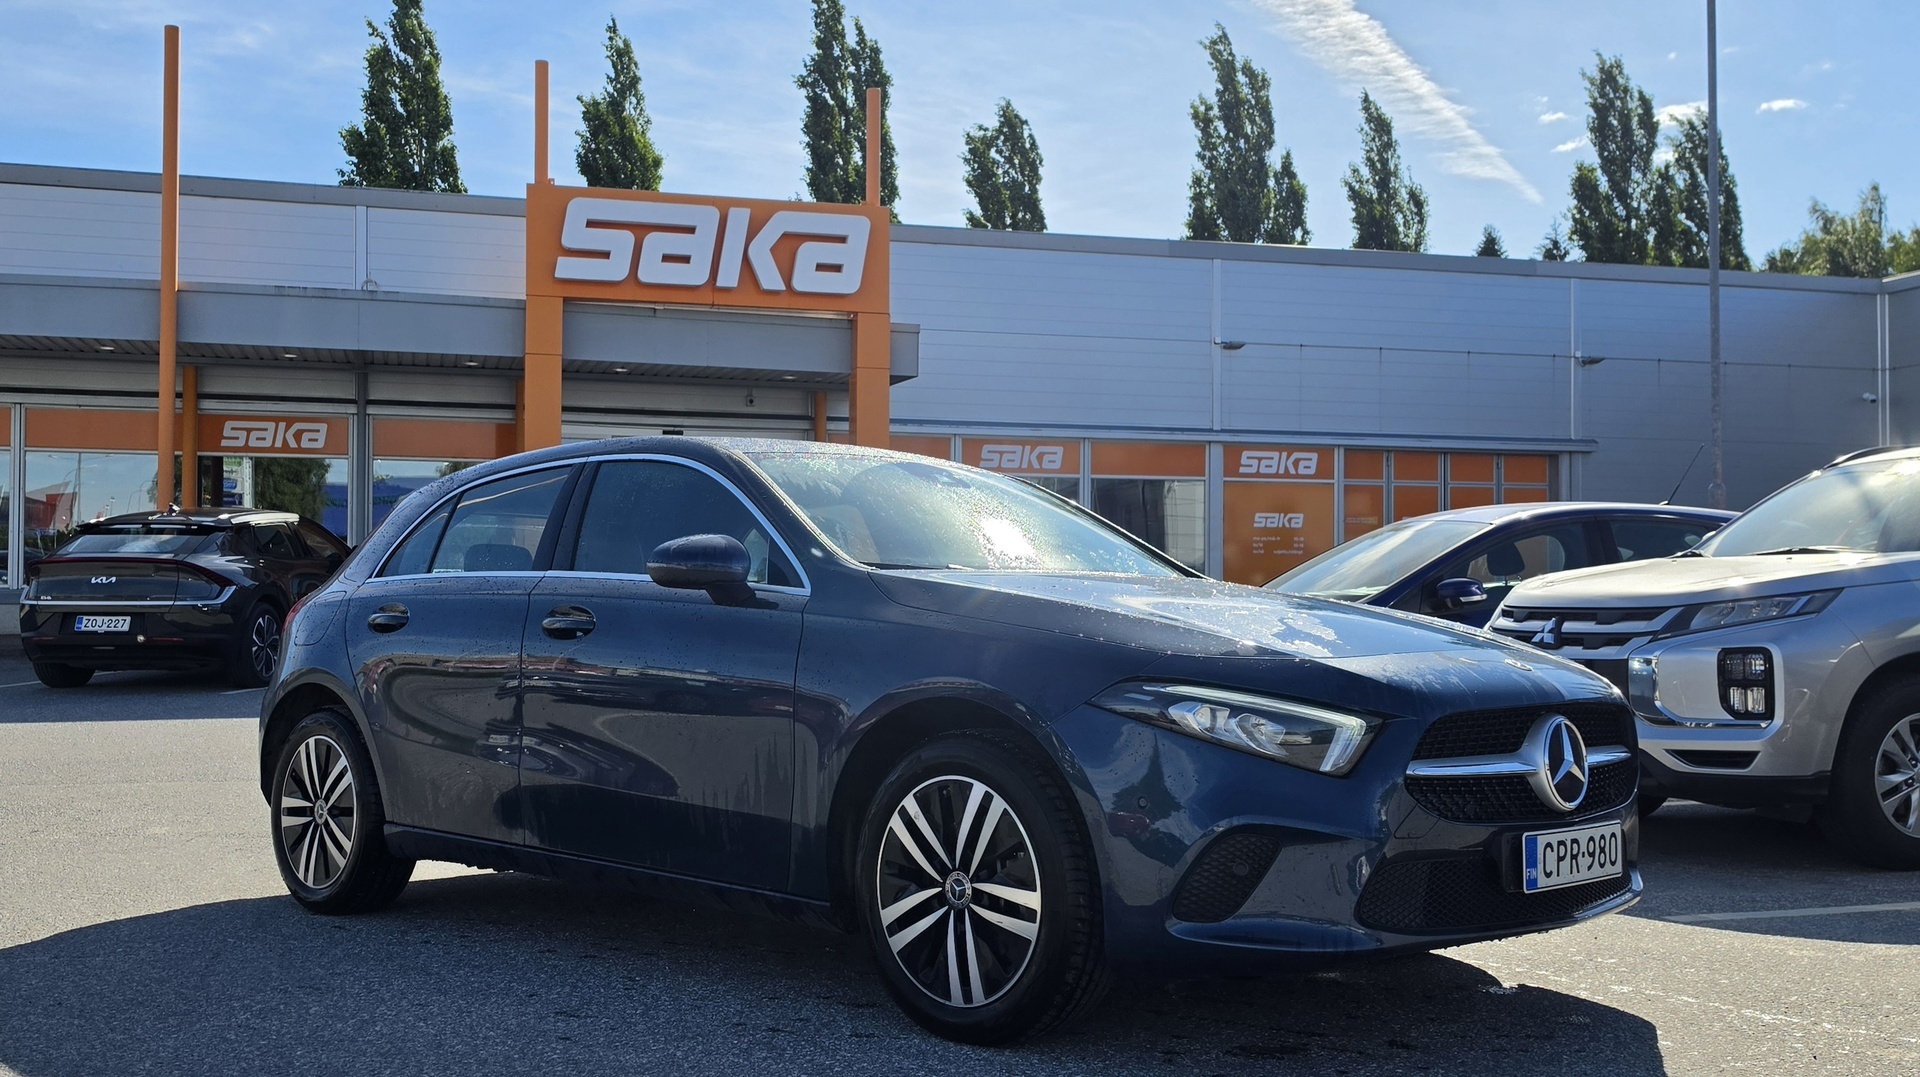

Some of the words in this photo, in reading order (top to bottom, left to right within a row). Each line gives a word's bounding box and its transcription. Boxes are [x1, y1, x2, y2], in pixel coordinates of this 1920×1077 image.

[83, 618, 128, 629] ZOJ-227
[1543, 831, 1618, 879] CPR-980
[1526, 867, 1537, 880] FIN
